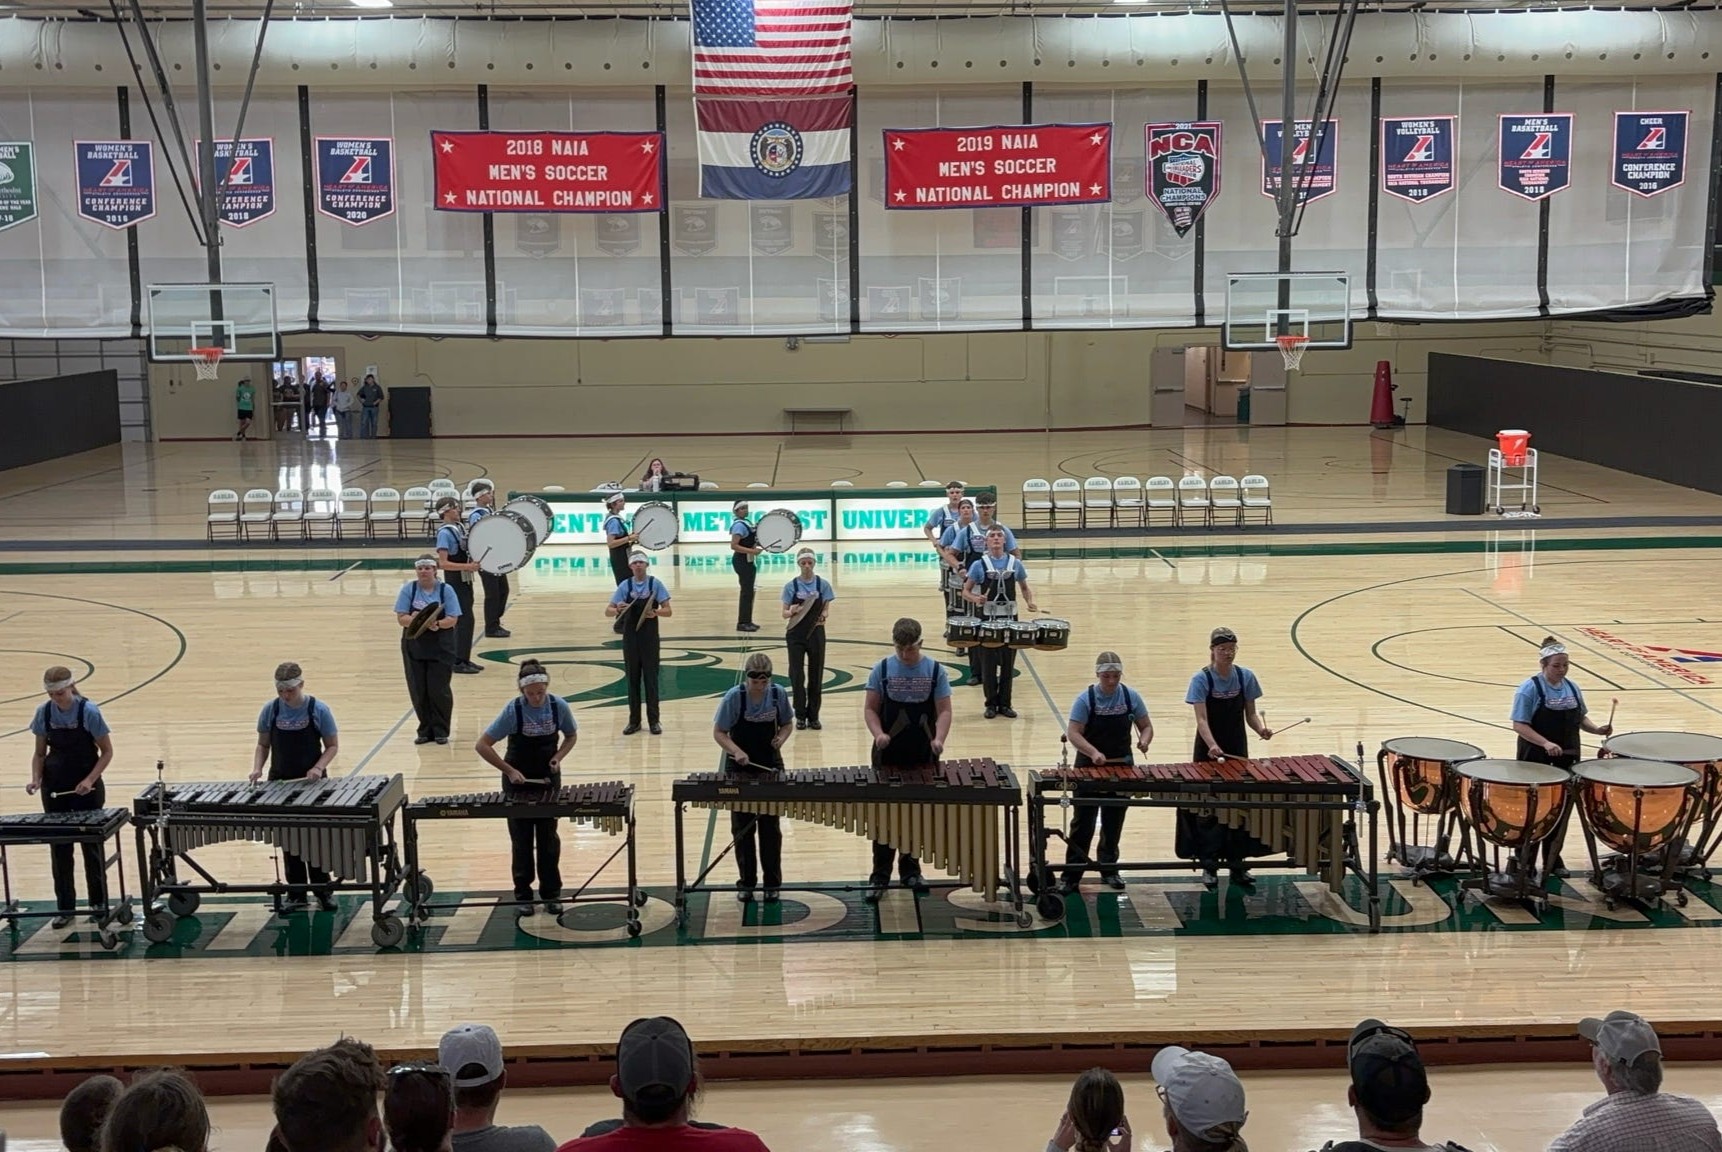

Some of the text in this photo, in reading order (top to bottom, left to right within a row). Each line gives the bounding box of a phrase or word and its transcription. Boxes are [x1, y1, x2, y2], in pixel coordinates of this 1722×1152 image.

[506, 140, 589, 156] 2018 NAIA
[957, 134, 1038, 152] 2019 NAIA
[1149, 132, 1217, 161] NCA
[489, 165, 608, 181] MEN'S SOCCER
[939, 158, 1056, 177] MEN'S SOCCER
[1623, 163, 1676, 171] CONFERENCE
[1628, 171, 1670, 179] CHAMPION
[466, 190, 632, 206] NATIONAL CHAMPION
[916, 182, 1080, 203] NATIONAL CHAMPION
[842, 509, 931, 530] UNIVER
